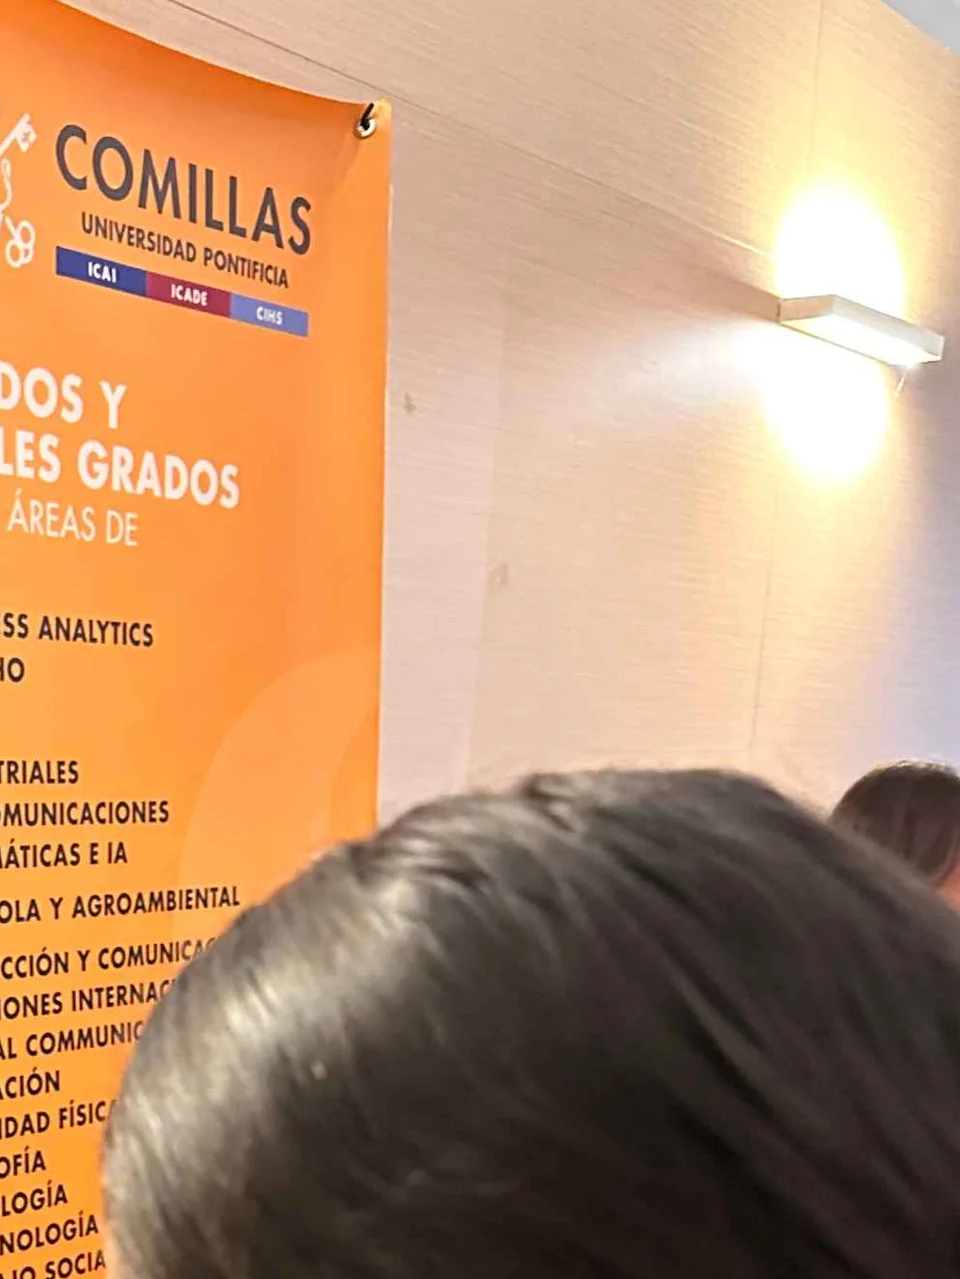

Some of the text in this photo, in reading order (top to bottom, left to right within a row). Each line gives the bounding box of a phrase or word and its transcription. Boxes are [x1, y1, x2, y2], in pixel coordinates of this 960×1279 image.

[56, 125, 312, 255] COMILLAS
[81, 212, 289, 289] UNIVERSIDAD PONTIFICIA
[88, 262, 117, 284] ICAI
[171, 284, 208, 307] ICADE
[256, 306, 283, 326] CIHS
[99, 381, 127, 430] Y
[78, 440, 240, 509] GRADOS
[7, 488, 97, 543] ÁREAS
[105, 509, 139, 546] DE
[39, 615, 154, 647] ANALYTICS
[90, 843, 100, 865] E
[108, 841, 128, 865] IA
[49, 897, 64, 920] Y
[71, 886, 241, 920] AGROAMBIENTAL
[77, 950, 91, 972] Y
[71, 978, 176, 1013] INTERNAC
[25, 1020, 144, 1057] COMMUNIC
[58, 1099, 112, 1131] FÍSIC
